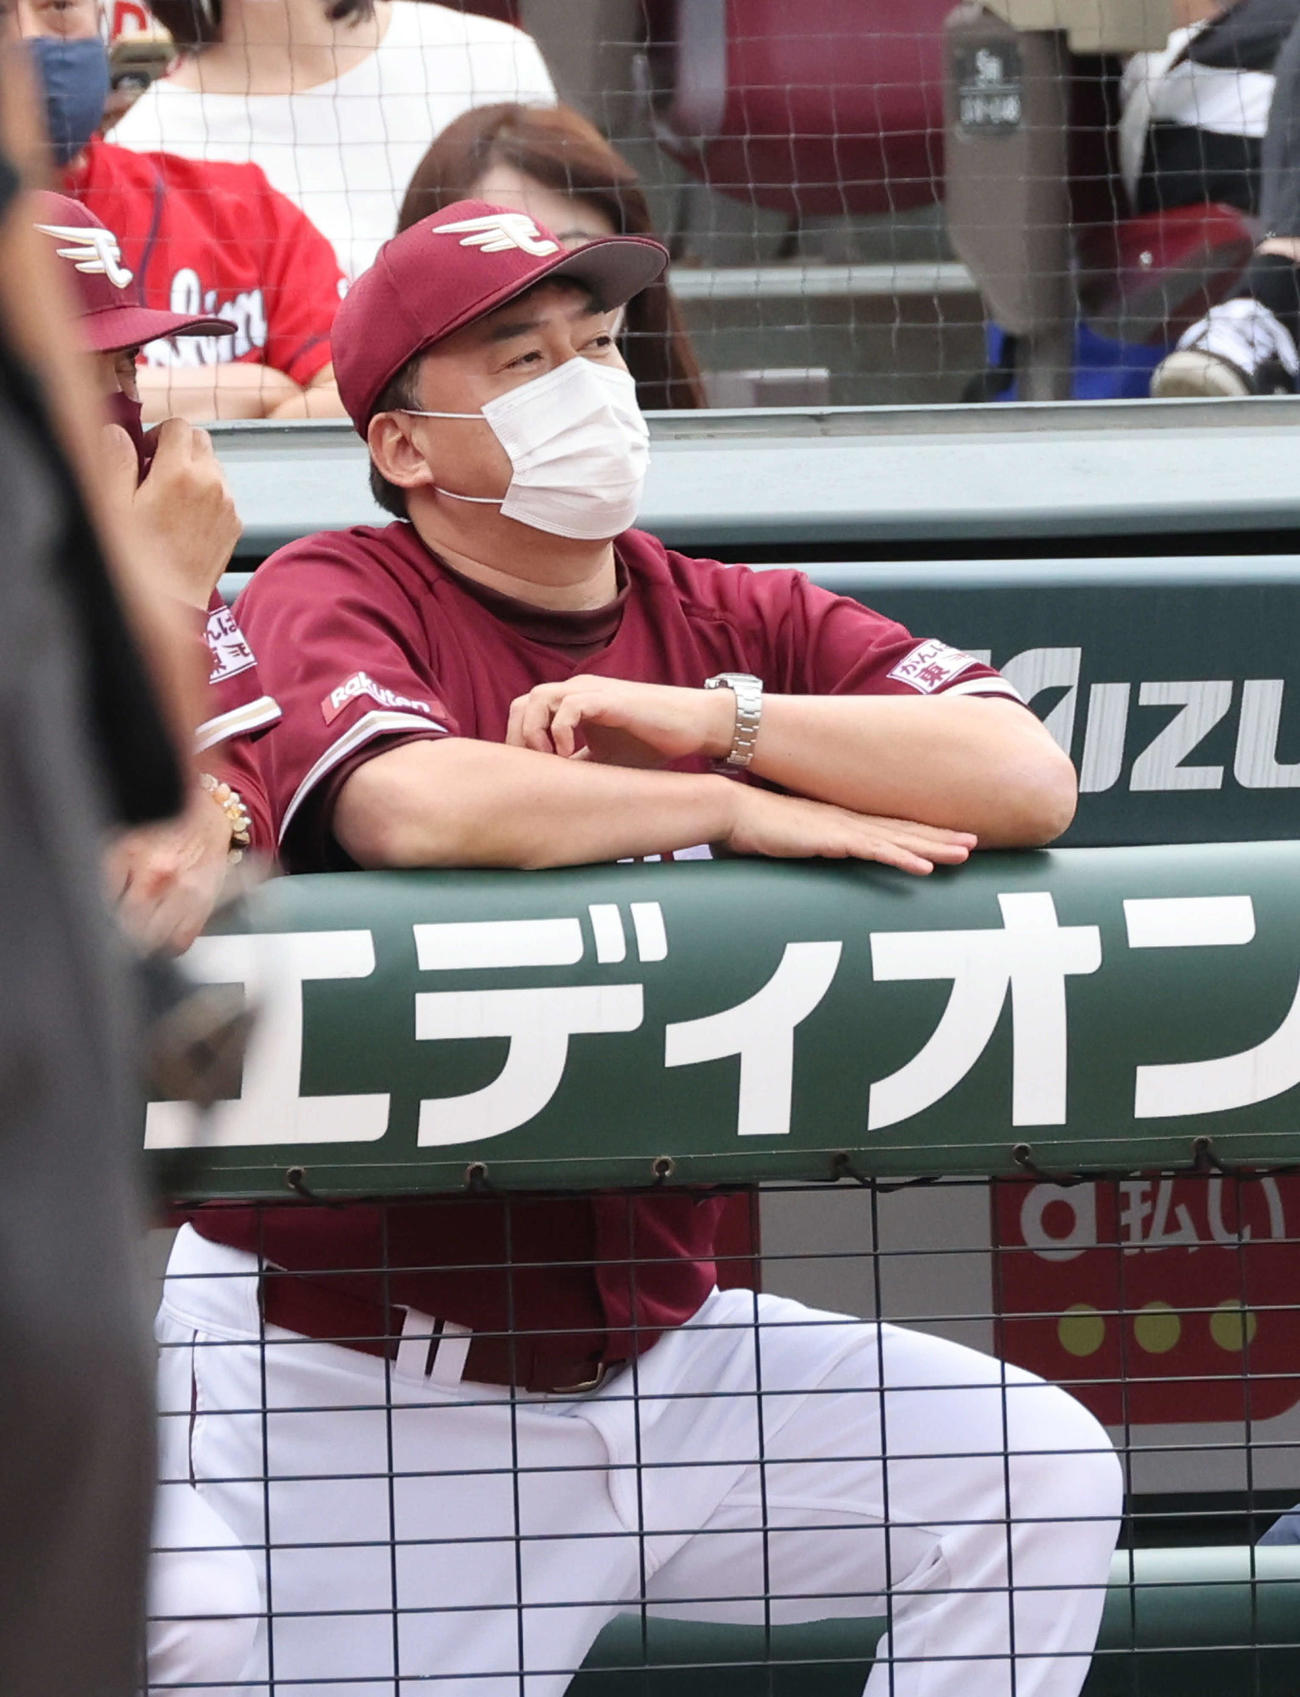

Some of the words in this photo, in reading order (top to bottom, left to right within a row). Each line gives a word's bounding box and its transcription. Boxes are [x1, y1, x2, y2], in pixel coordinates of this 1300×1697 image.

[329, 671, 432, 714] Rakuten
[143, 891, 1300, 1150] エディオン
